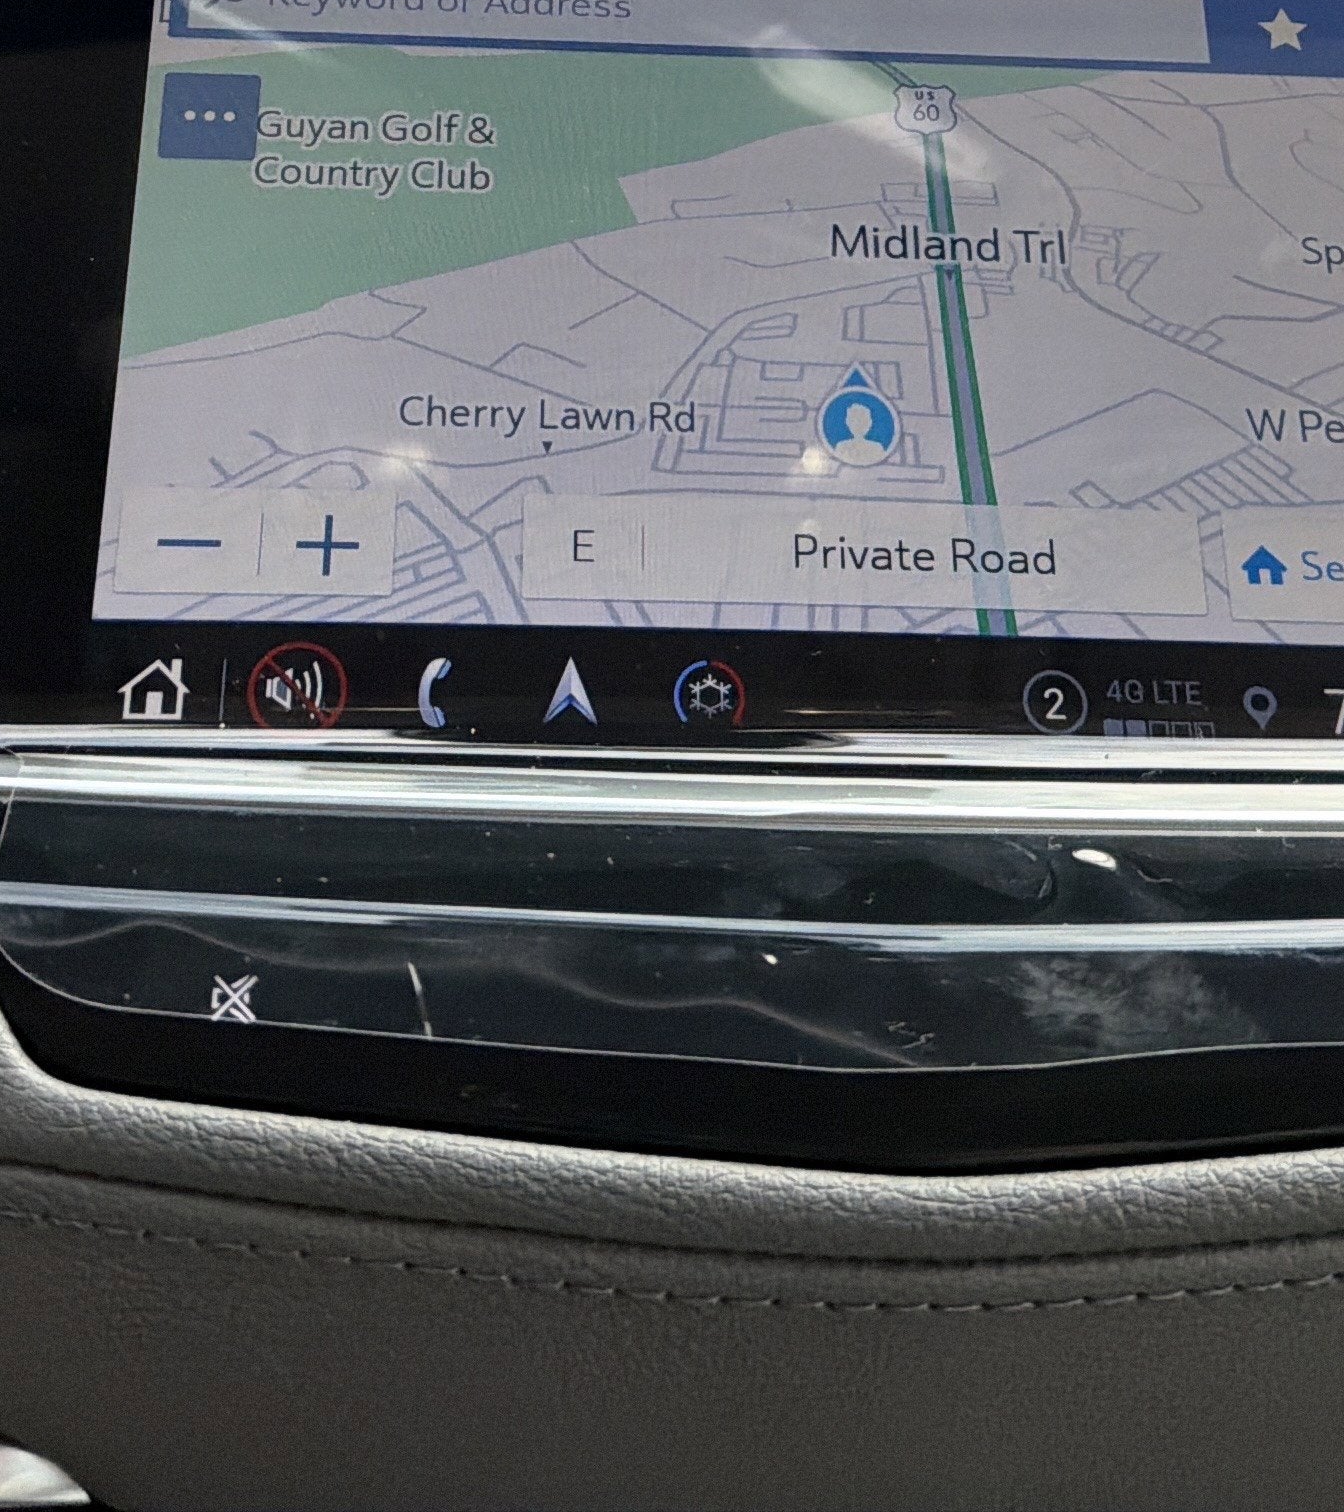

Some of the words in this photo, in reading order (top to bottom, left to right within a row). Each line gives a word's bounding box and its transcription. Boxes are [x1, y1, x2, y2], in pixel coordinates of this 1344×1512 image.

[256, 111, 369, 146] Guyan
[381, 114, 458, 144] Golf
[468, 116, 495, 144] &
[913, 103, 940, 121] 60
[254, 157, 399, 195] Country
[411, 161, 490, 191] Club
[831, 225, 1001, 263] Midland
[1012, 230, 1066, 266] Trl
[400, 395, 525, 437] Cherry
[539, 399, 636, 431] Lawn
[648, 402, 696, 433] Rd
[1246, 408, 1287, 441] W
[573, 530, 594, 562] E
[793, 534, 936, 573] Private
[951, 538, 1056, 575] Road
[1043, 688, 1067, 720] 2
[1107, 679, 1144, 704] 4G
[1152, 680, 1204, 706] LTE
